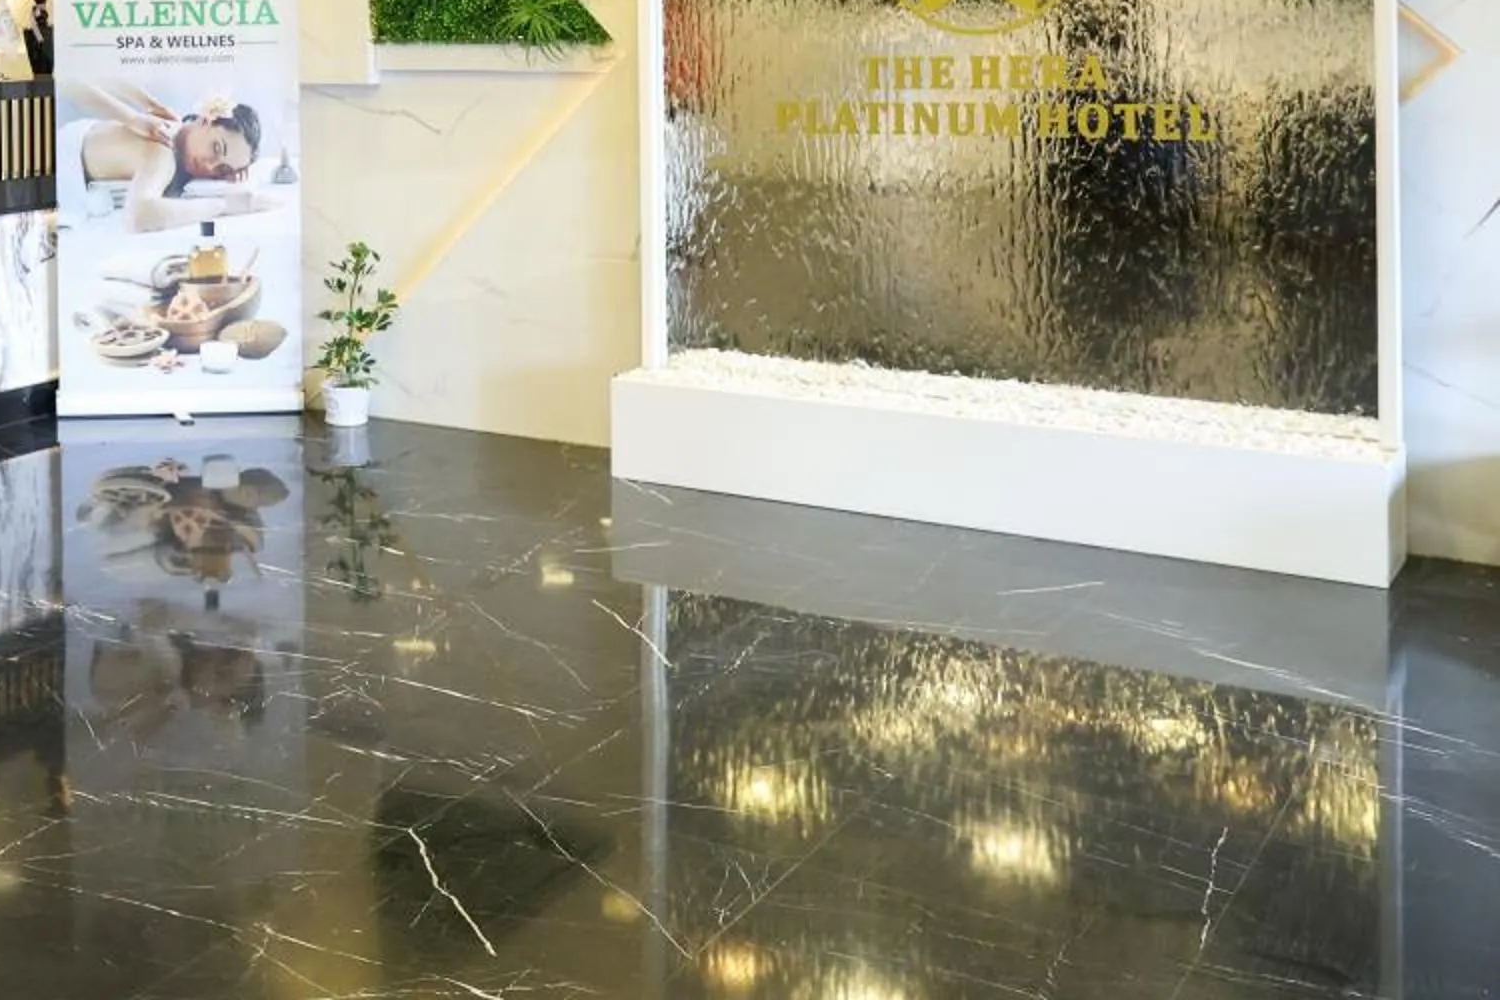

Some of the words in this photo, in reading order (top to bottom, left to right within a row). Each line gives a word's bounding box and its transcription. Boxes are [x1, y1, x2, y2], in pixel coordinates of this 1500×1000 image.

[116, 35, 145, 49] SPA
[149, 35, 163, 49] &
[167, 34, 235, 48] WELLNES
[860, 56, 955, 89] THE
[971, 56, 1107, 89] HERA
[775, 101, 1021, 137] PLATINUM
[1038, 104, 1218, 141] HOTEL
